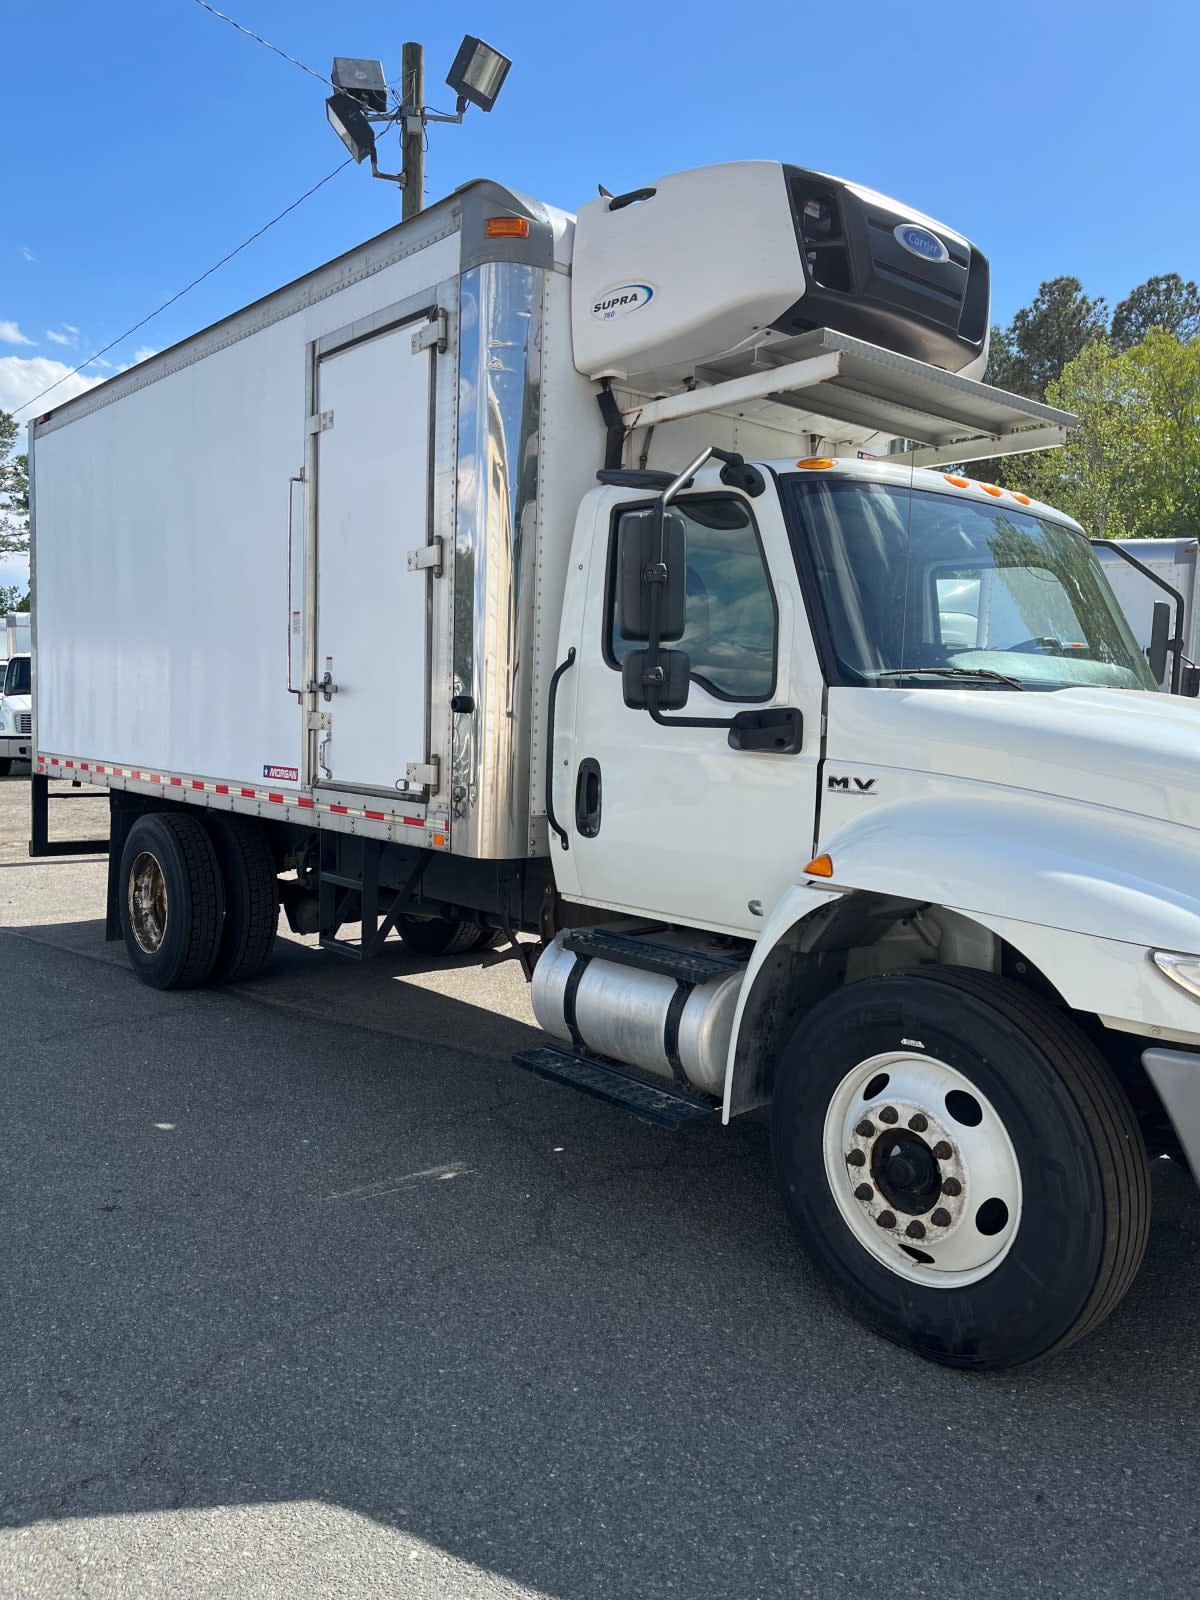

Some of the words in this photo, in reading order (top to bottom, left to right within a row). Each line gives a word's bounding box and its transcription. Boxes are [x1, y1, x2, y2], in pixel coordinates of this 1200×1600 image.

[909, 233, 938, 254] Carrier
[593, 293, 638, 312] SUPRA
[269, 767, 298, 780] MORGAN
[828, 775, 876, 790] MV
